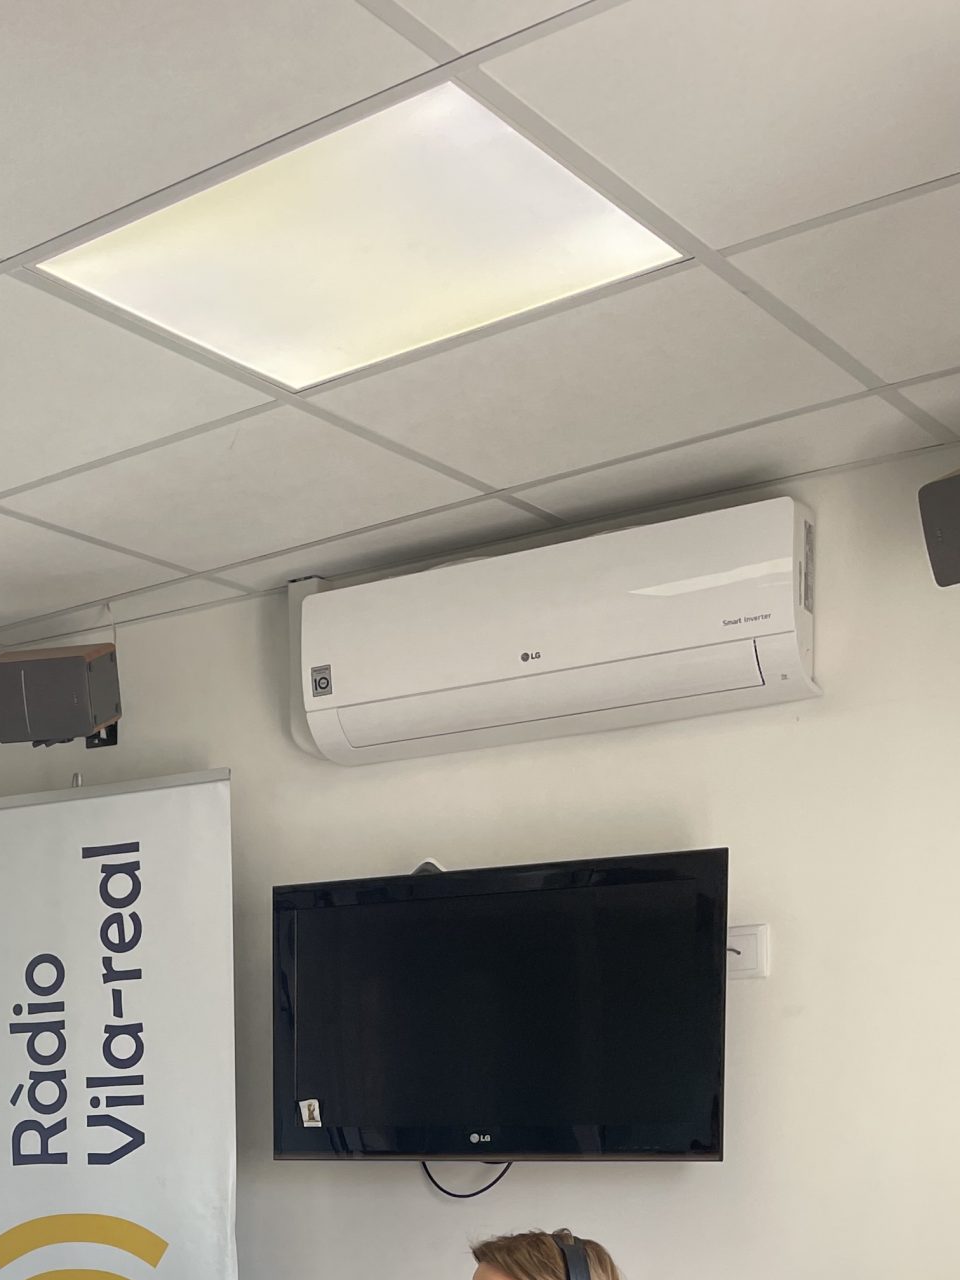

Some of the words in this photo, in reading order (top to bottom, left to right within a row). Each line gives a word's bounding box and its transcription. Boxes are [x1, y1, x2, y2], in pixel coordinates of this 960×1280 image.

[722, 618, 742, 626] Smart
[743, 613, 771, 623] Inverter
[530, 651, 541, 660] LG
[81, 841, 146, 1165] Vila-real
[9, 953, 68, 1166] Ràdio
[480, 1134, 491, 1142] LG
